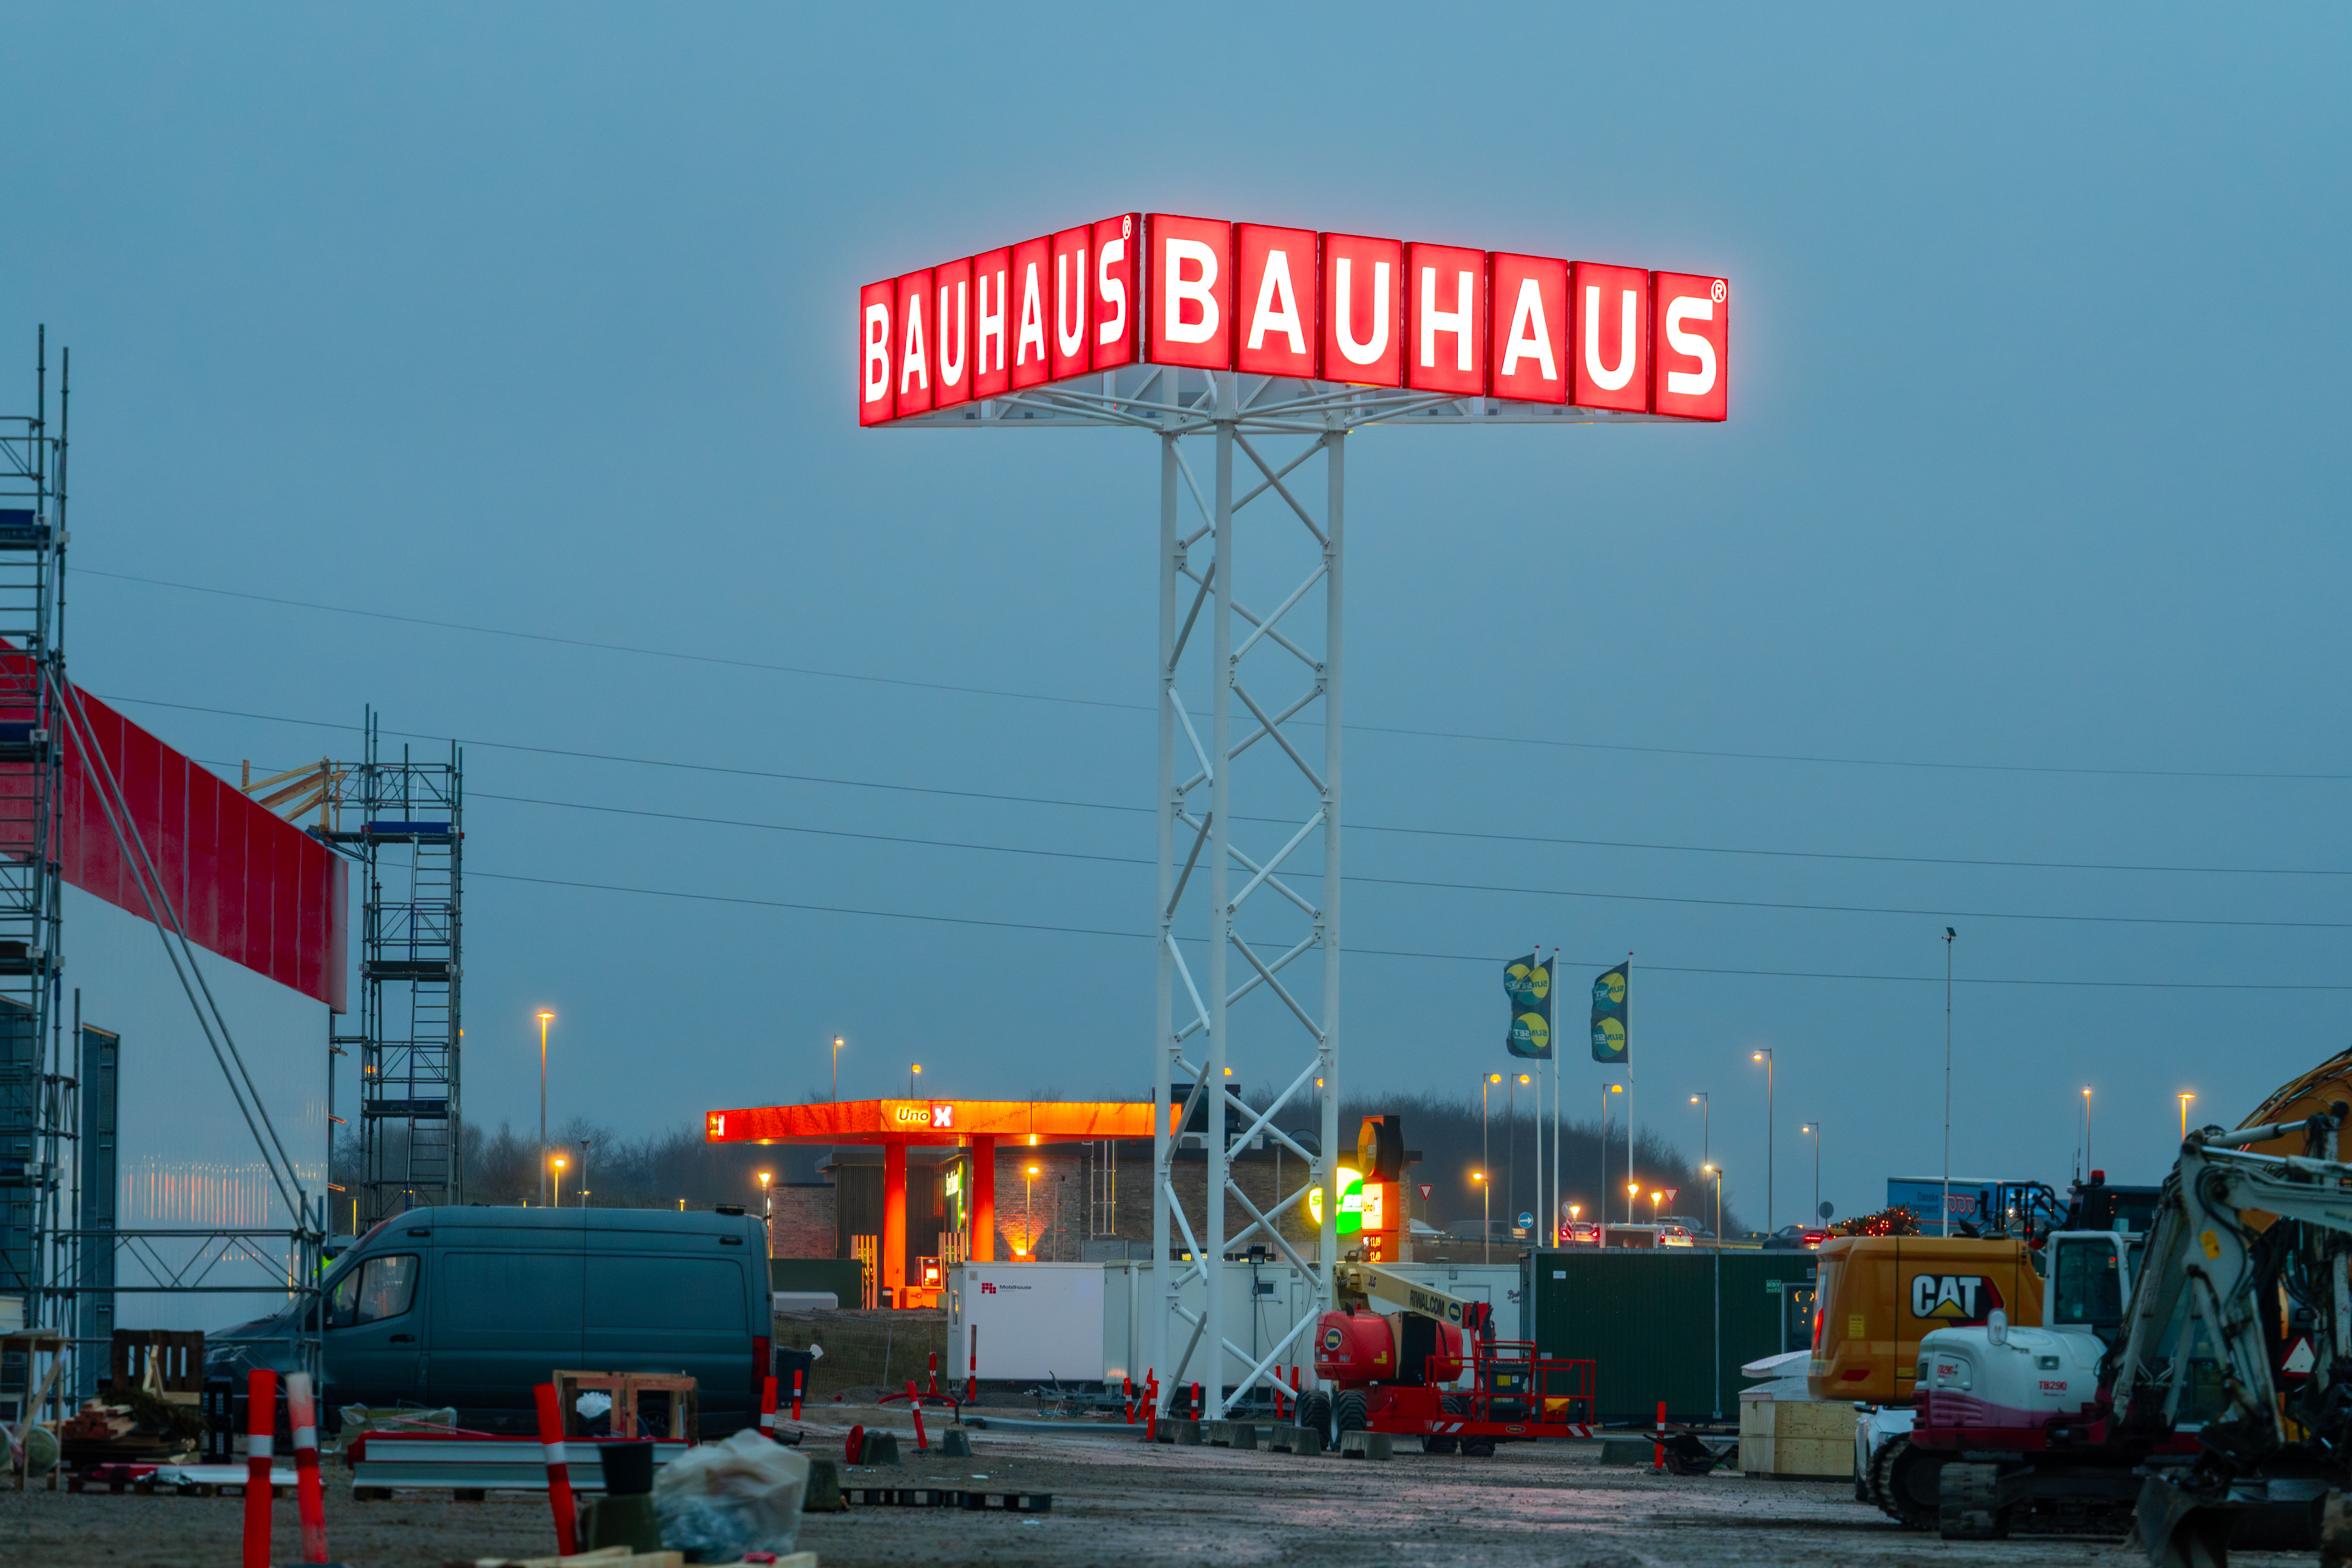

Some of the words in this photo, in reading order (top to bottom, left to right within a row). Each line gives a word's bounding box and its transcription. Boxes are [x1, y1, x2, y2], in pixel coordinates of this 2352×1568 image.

[897, 1108, 929, 1122] Uno
[934, 1106, 952, 1126] X
[1364, 1201, 1373, 1212] Uno
[1370, 1236, 1381, 1248] 13,09
[1370, 1251, 1381, 1263] 12,49
[1368, 1275, 1377, 1288] JLG
[1912, 1275, 1982, 1318] CAT
[2038, 1380, 2067, 1391] TB290
